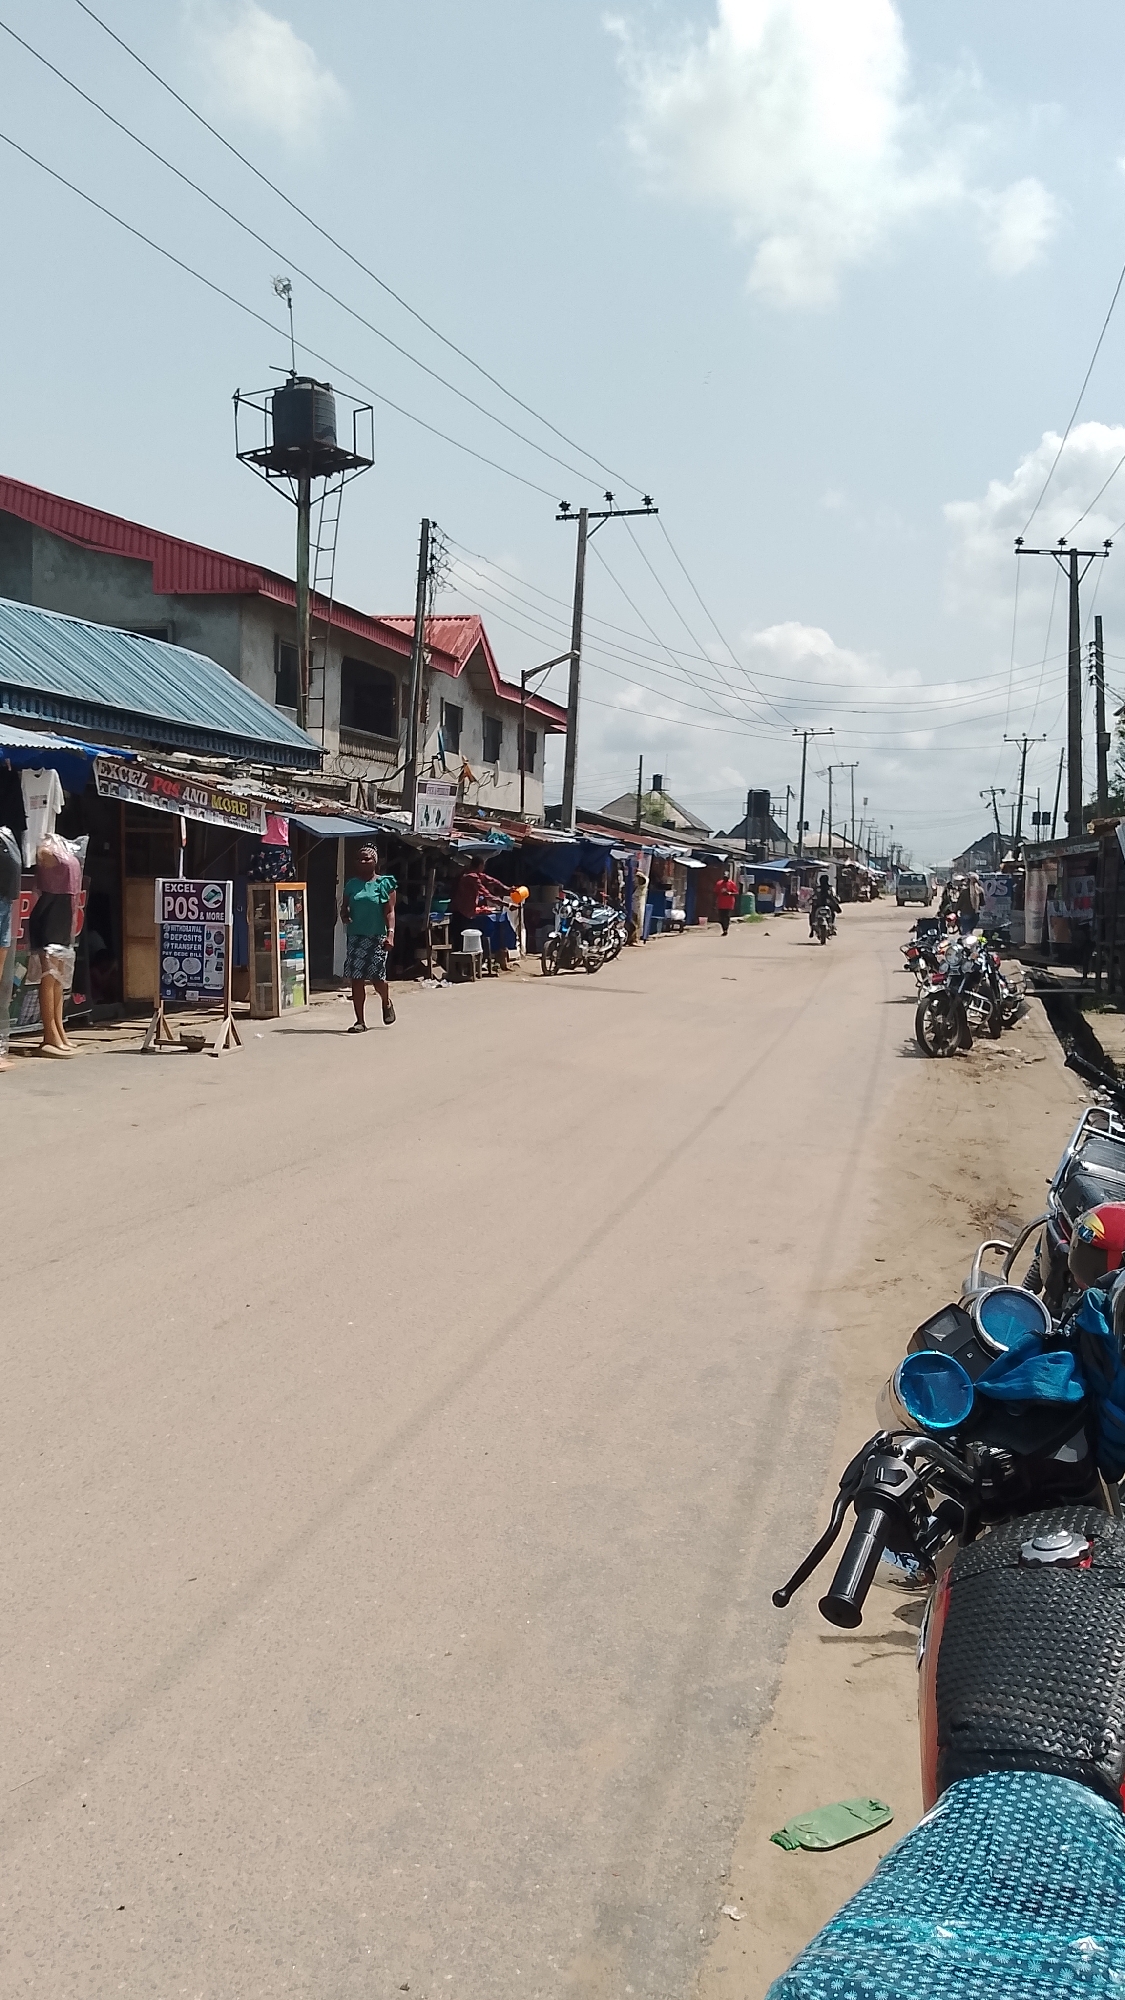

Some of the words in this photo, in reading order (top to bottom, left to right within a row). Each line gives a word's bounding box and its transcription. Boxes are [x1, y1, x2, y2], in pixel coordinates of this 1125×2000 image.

[98, 760, 149, 789] EXCEL
[151, 777, 181, 798] POS
[181, 786, 209, 806] AND
[211, 794, 249, 817] MORE
[164, 883, 196, 893] EXCEL
[979, 879, 1008, 896] OS
[164, 896, 199, 920] POS
[199, 912, 205, 920] &
[206, 912, 225, 921] MORE
[170, 924, 203, 933] WITHDRAWAL
[170, 933, 203, 942] DEPOSITS
[170, 942, 202, 951] TRANSFER
